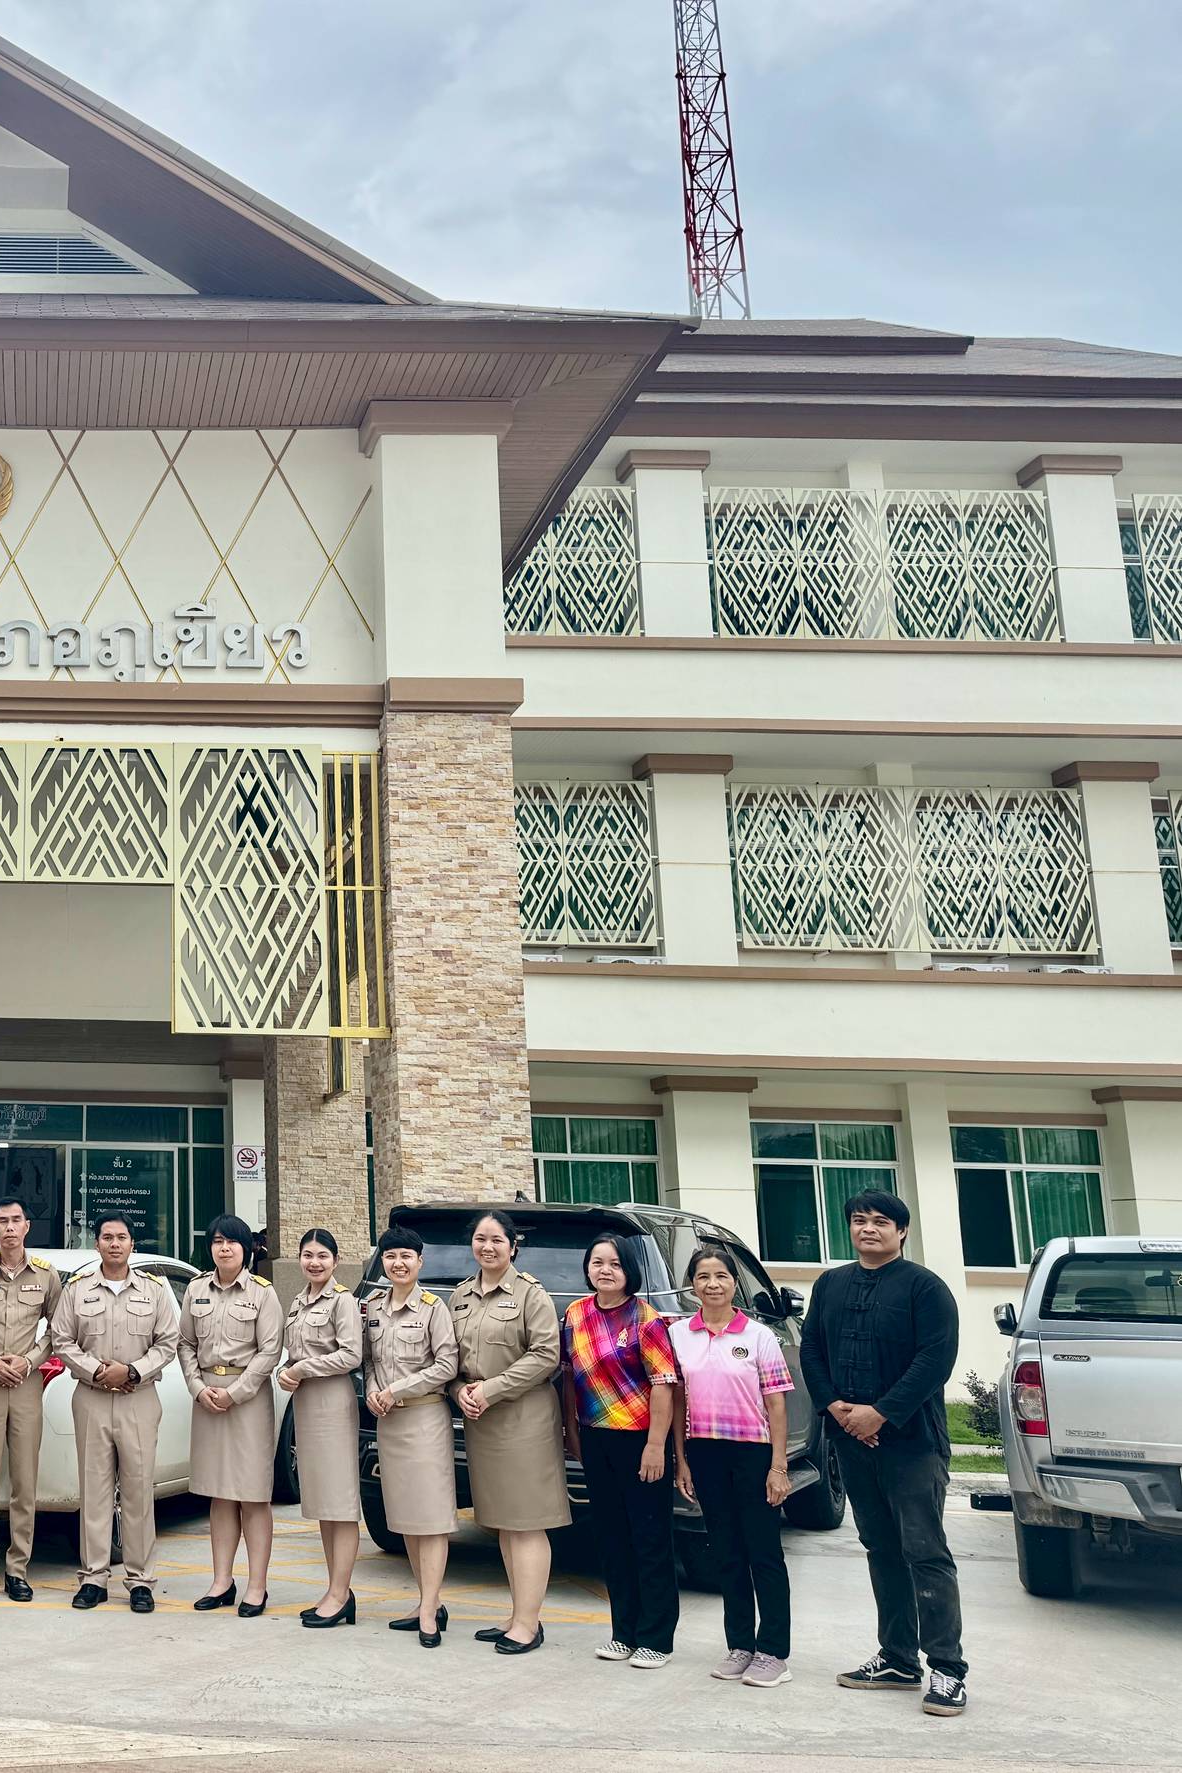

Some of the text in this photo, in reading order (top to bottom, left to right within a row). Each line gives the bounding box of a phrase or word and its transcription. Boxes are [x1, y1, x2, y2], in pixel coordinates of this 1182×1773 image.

[113, 1156, 133, 1168] ชั้น 2
[1065, 1429, 1107, 1438] ISUZU
